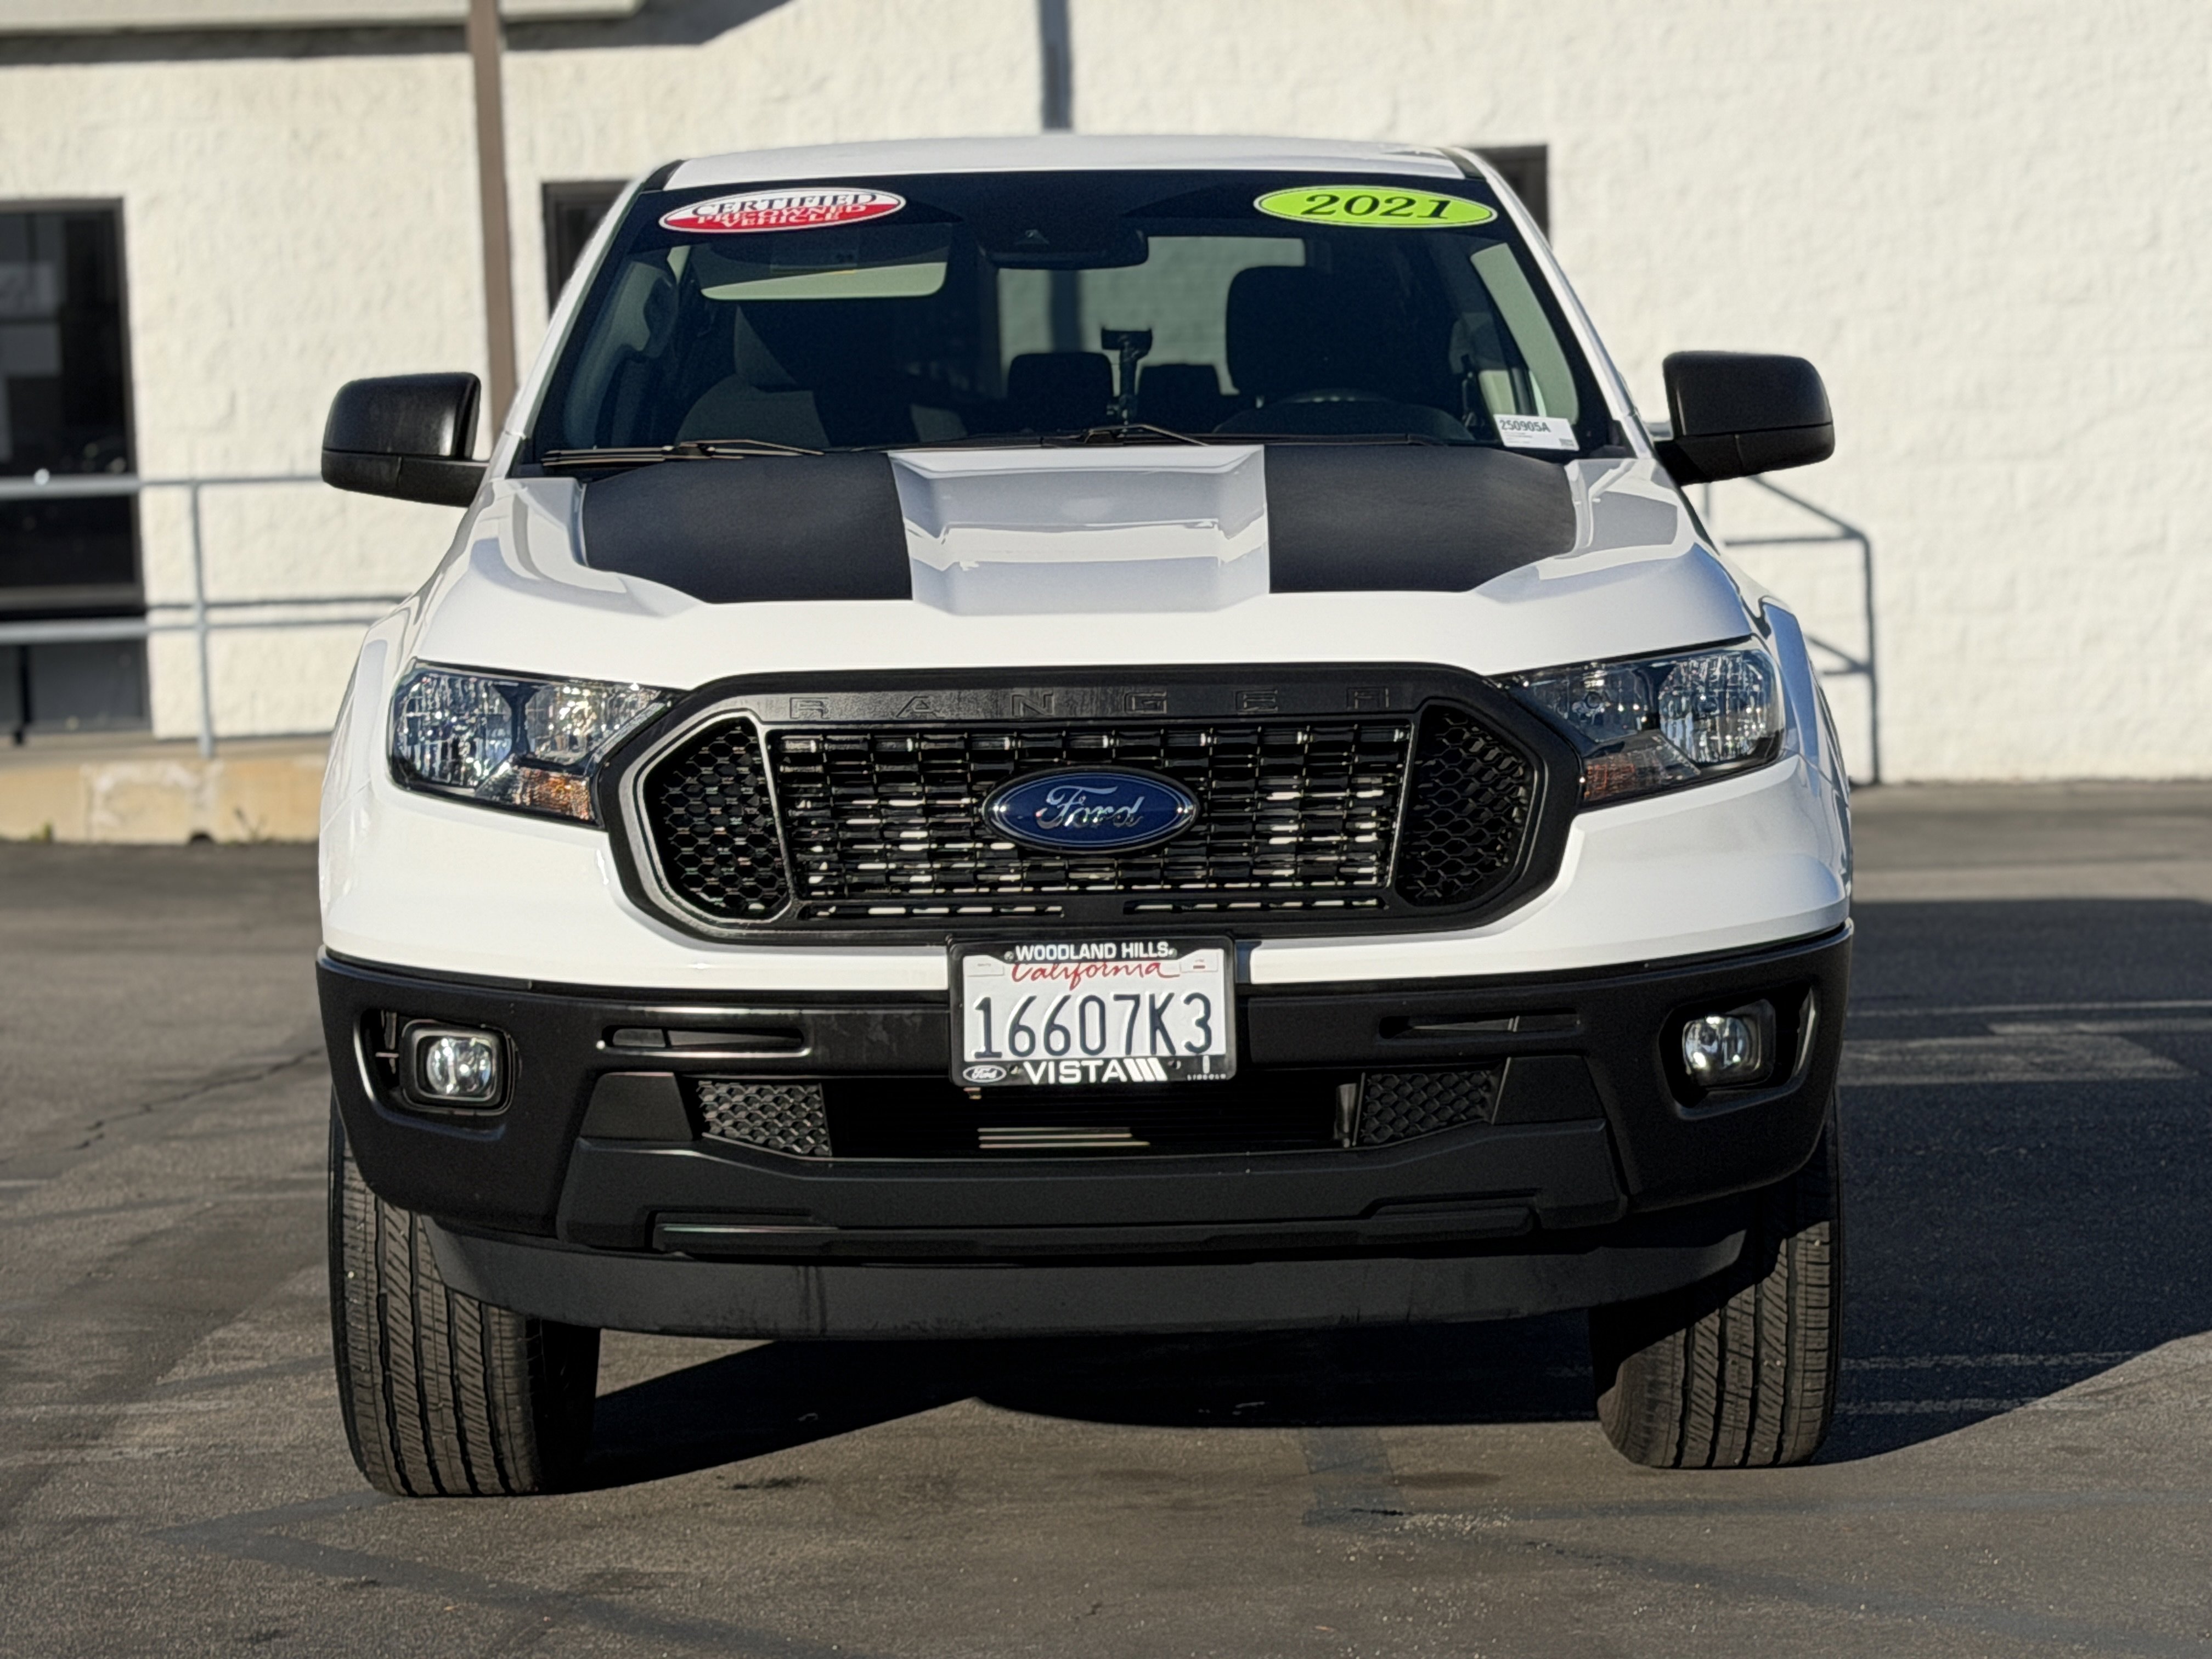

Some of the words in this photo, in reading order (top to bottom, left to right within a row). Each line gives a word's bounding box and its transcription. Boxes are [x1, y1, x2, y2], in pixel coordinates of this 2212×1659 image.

[692, 194, 877, 216] CERTIFIED
[1300, 194, 1452, 219] 2021
[722, 212, 840, 227] VEHICLE
[1499, 420, 1551, 433] 250905A
[789, 686, 1389, 719] RANGER
[1035, 785, 1146, 830] Ford
[1015, 943, 1116, 961] WOODLAND
[1121, 941, 1169, 959] HILLS
[1011, 962, 1180, 991] California
[973, 992, 1213, 1059] 16607K3
[1023, 1058, 1128, 1085] VISTA
